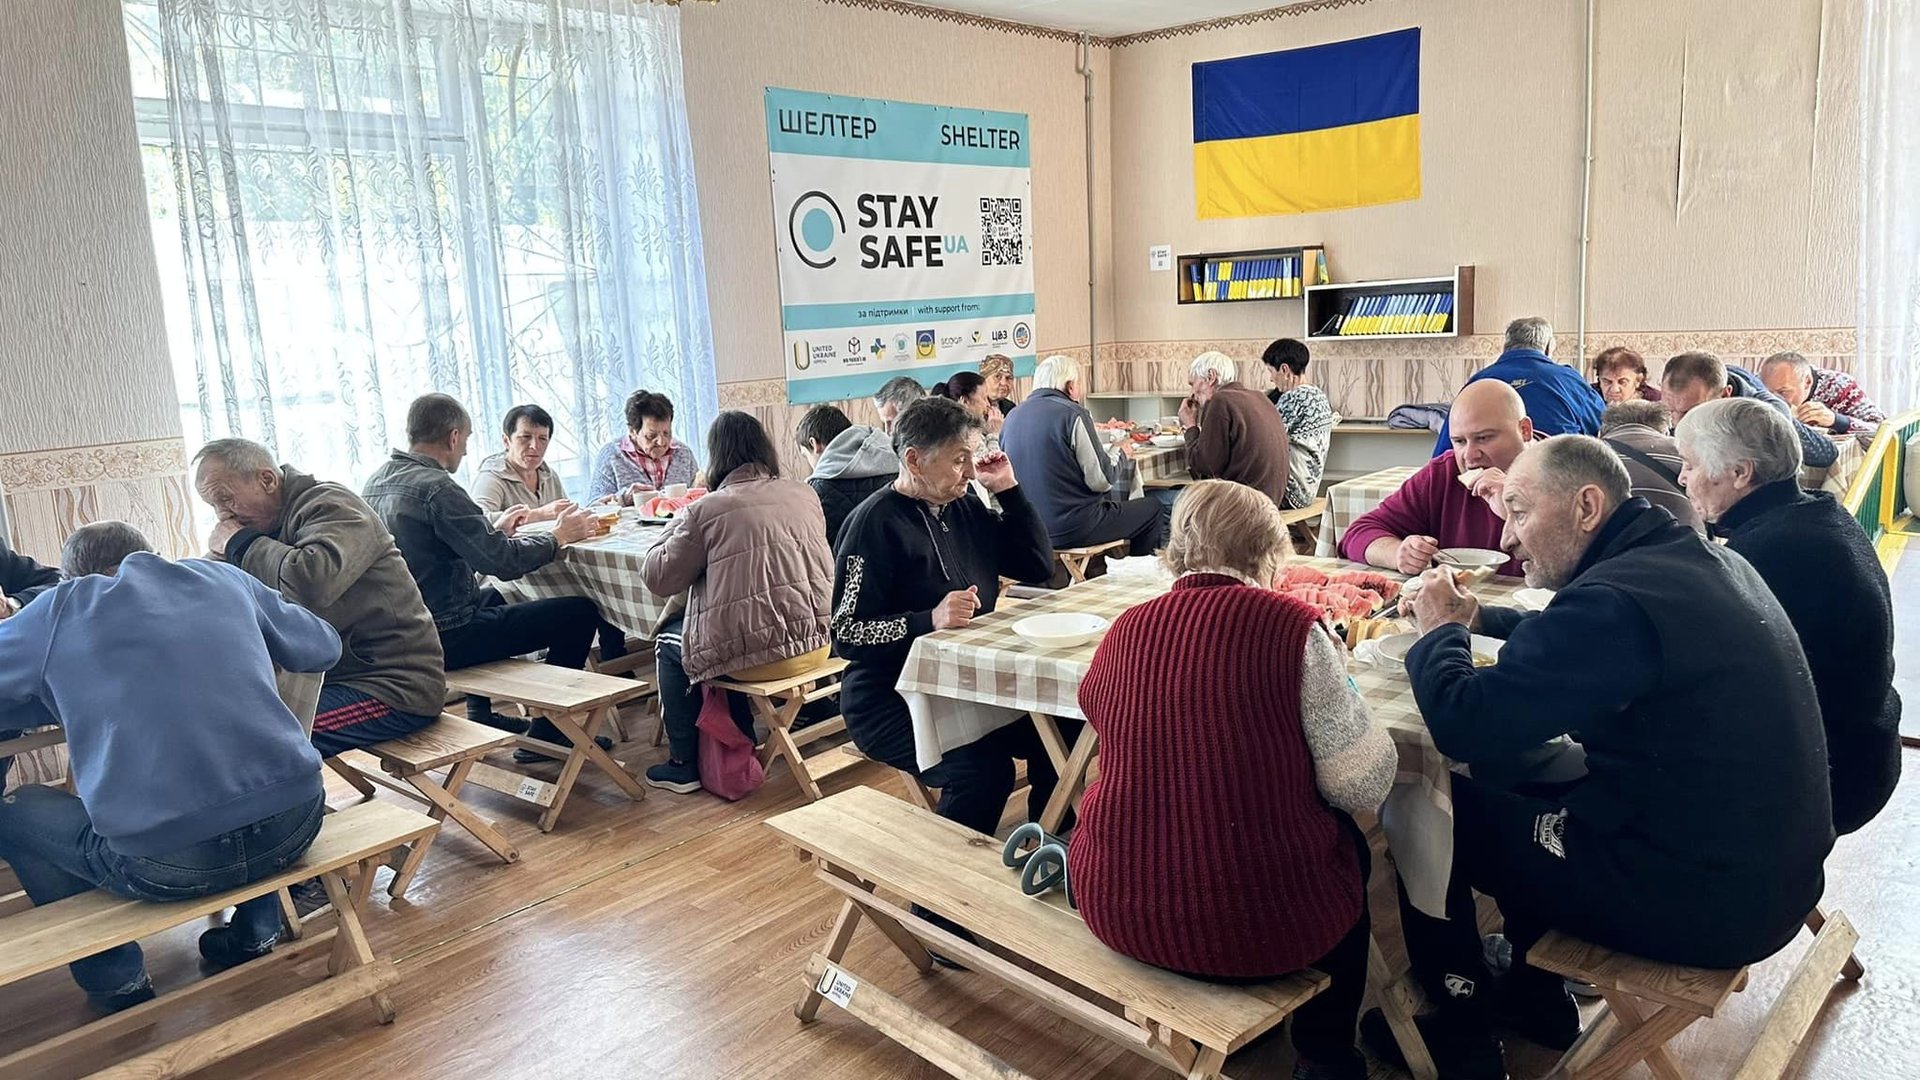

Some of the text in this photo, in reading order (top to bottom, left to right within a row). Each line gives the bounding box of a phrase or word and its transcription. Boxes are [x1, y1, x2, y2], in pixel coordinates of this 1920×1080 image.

[779, 109, 877, 139] ШЕЛТЕР
[941, 124, 1020, 150] SHELTER
[857, 193, 939, 229] STAY
[859, 234, 969, 269] SAFE UA
[858, 307, 909, 319] за підтримки
[917, 305, 933, 314] with
[934, 304, 960, 315] support
